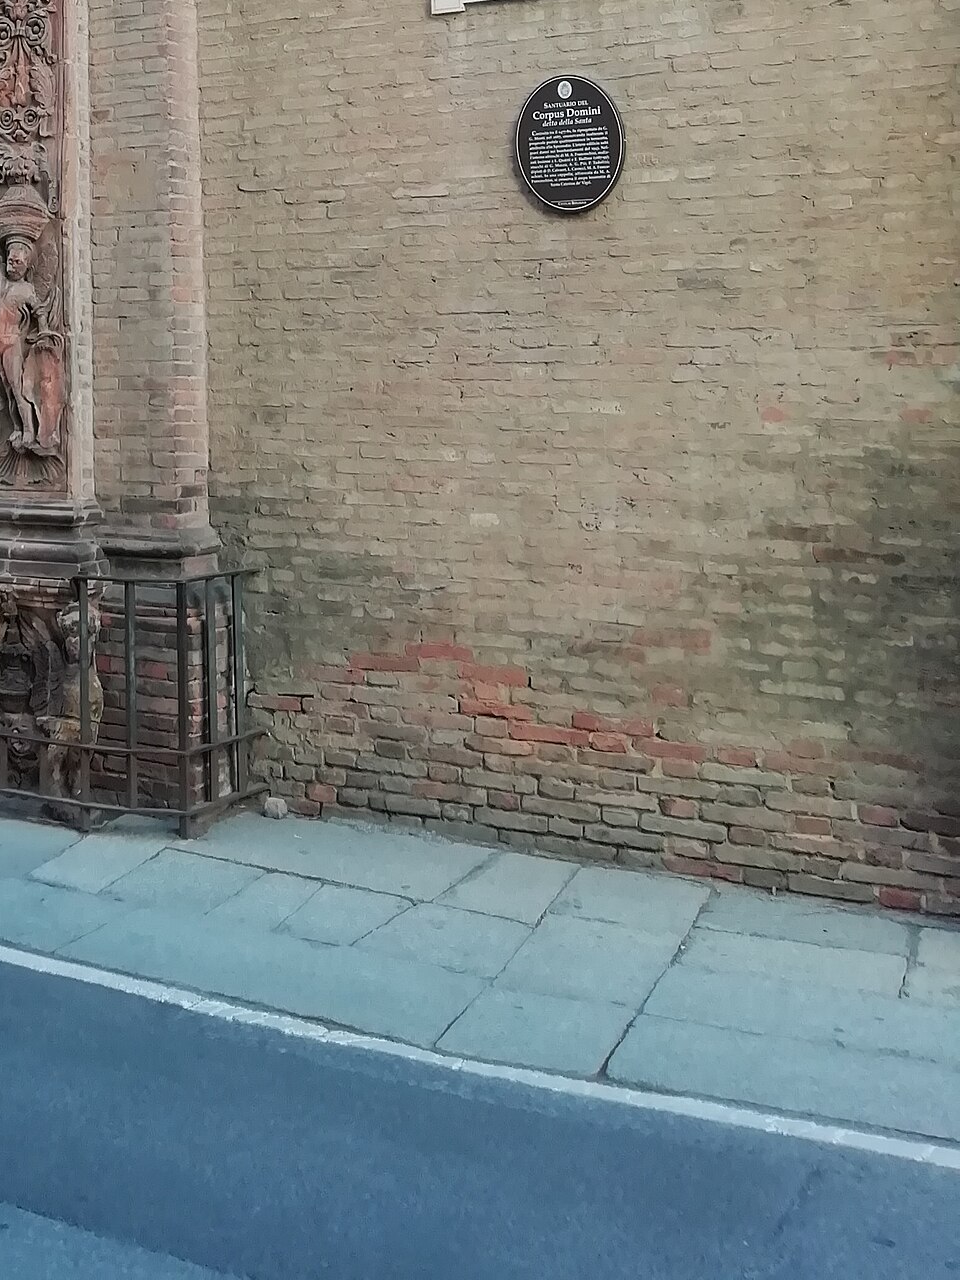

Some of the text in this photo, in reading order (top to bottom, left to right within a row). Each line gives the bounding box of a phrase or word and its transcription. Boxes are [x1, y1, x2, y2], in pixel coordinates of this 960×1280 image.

[533, 106, 601, 121] Corpus Domini
[559, 118, 573, 126] della
